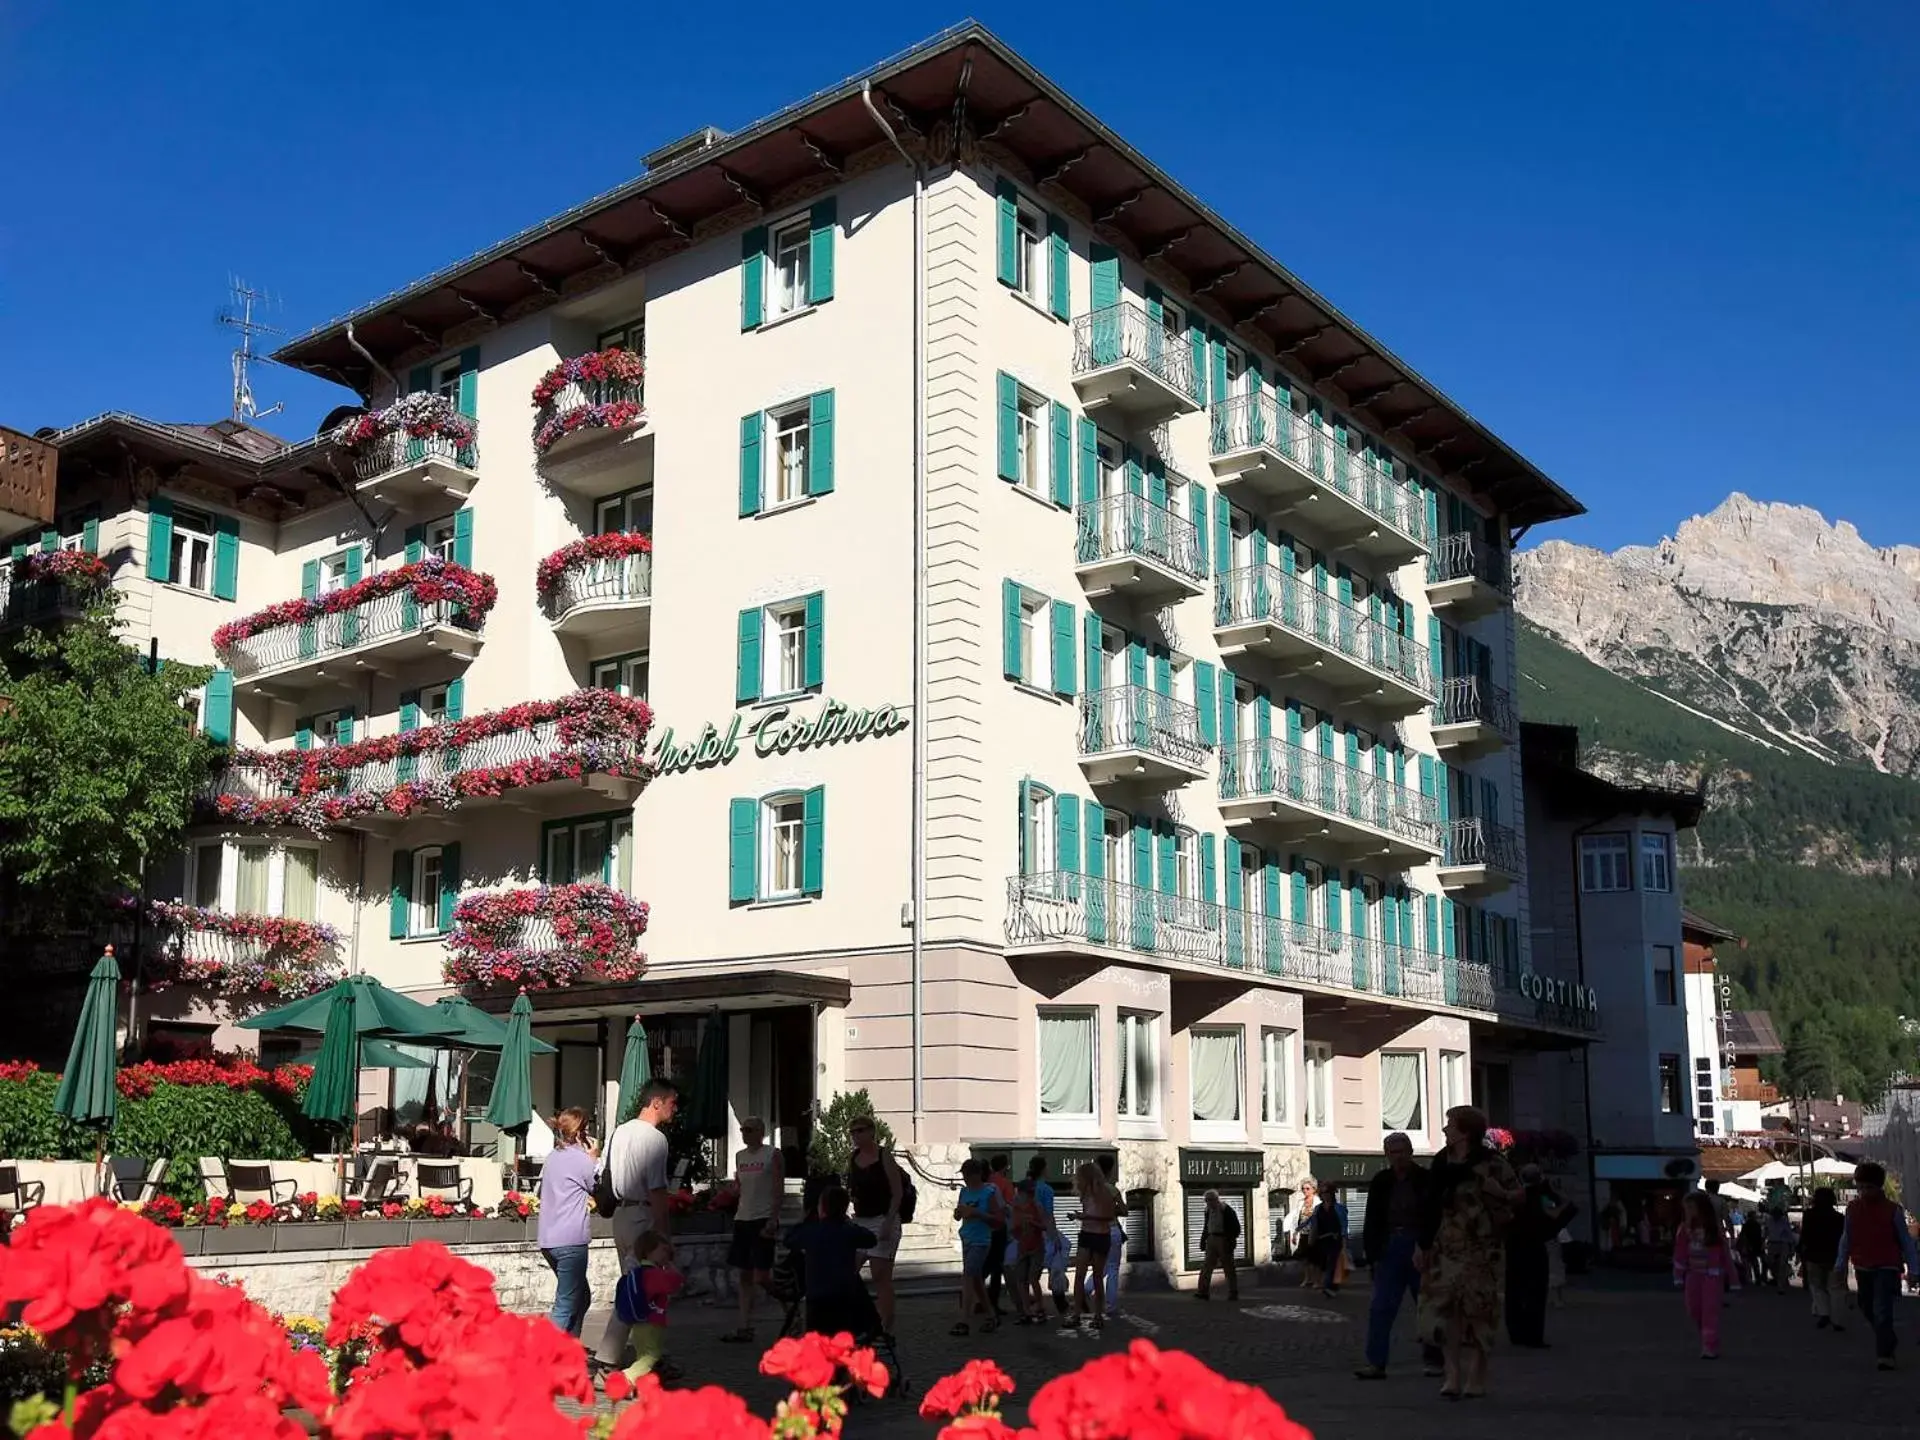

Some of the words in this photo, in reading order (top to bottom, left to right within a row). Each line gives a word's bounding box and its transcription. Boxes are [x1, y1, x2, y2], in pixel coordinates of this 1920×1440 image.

[652, 713, 742, 776] hotel
[748, 697, 909, 757] Cortina
[1520, 973, 1598, 1012] CORTINA
[1719, 974, 1733, 1032] HOTEL
